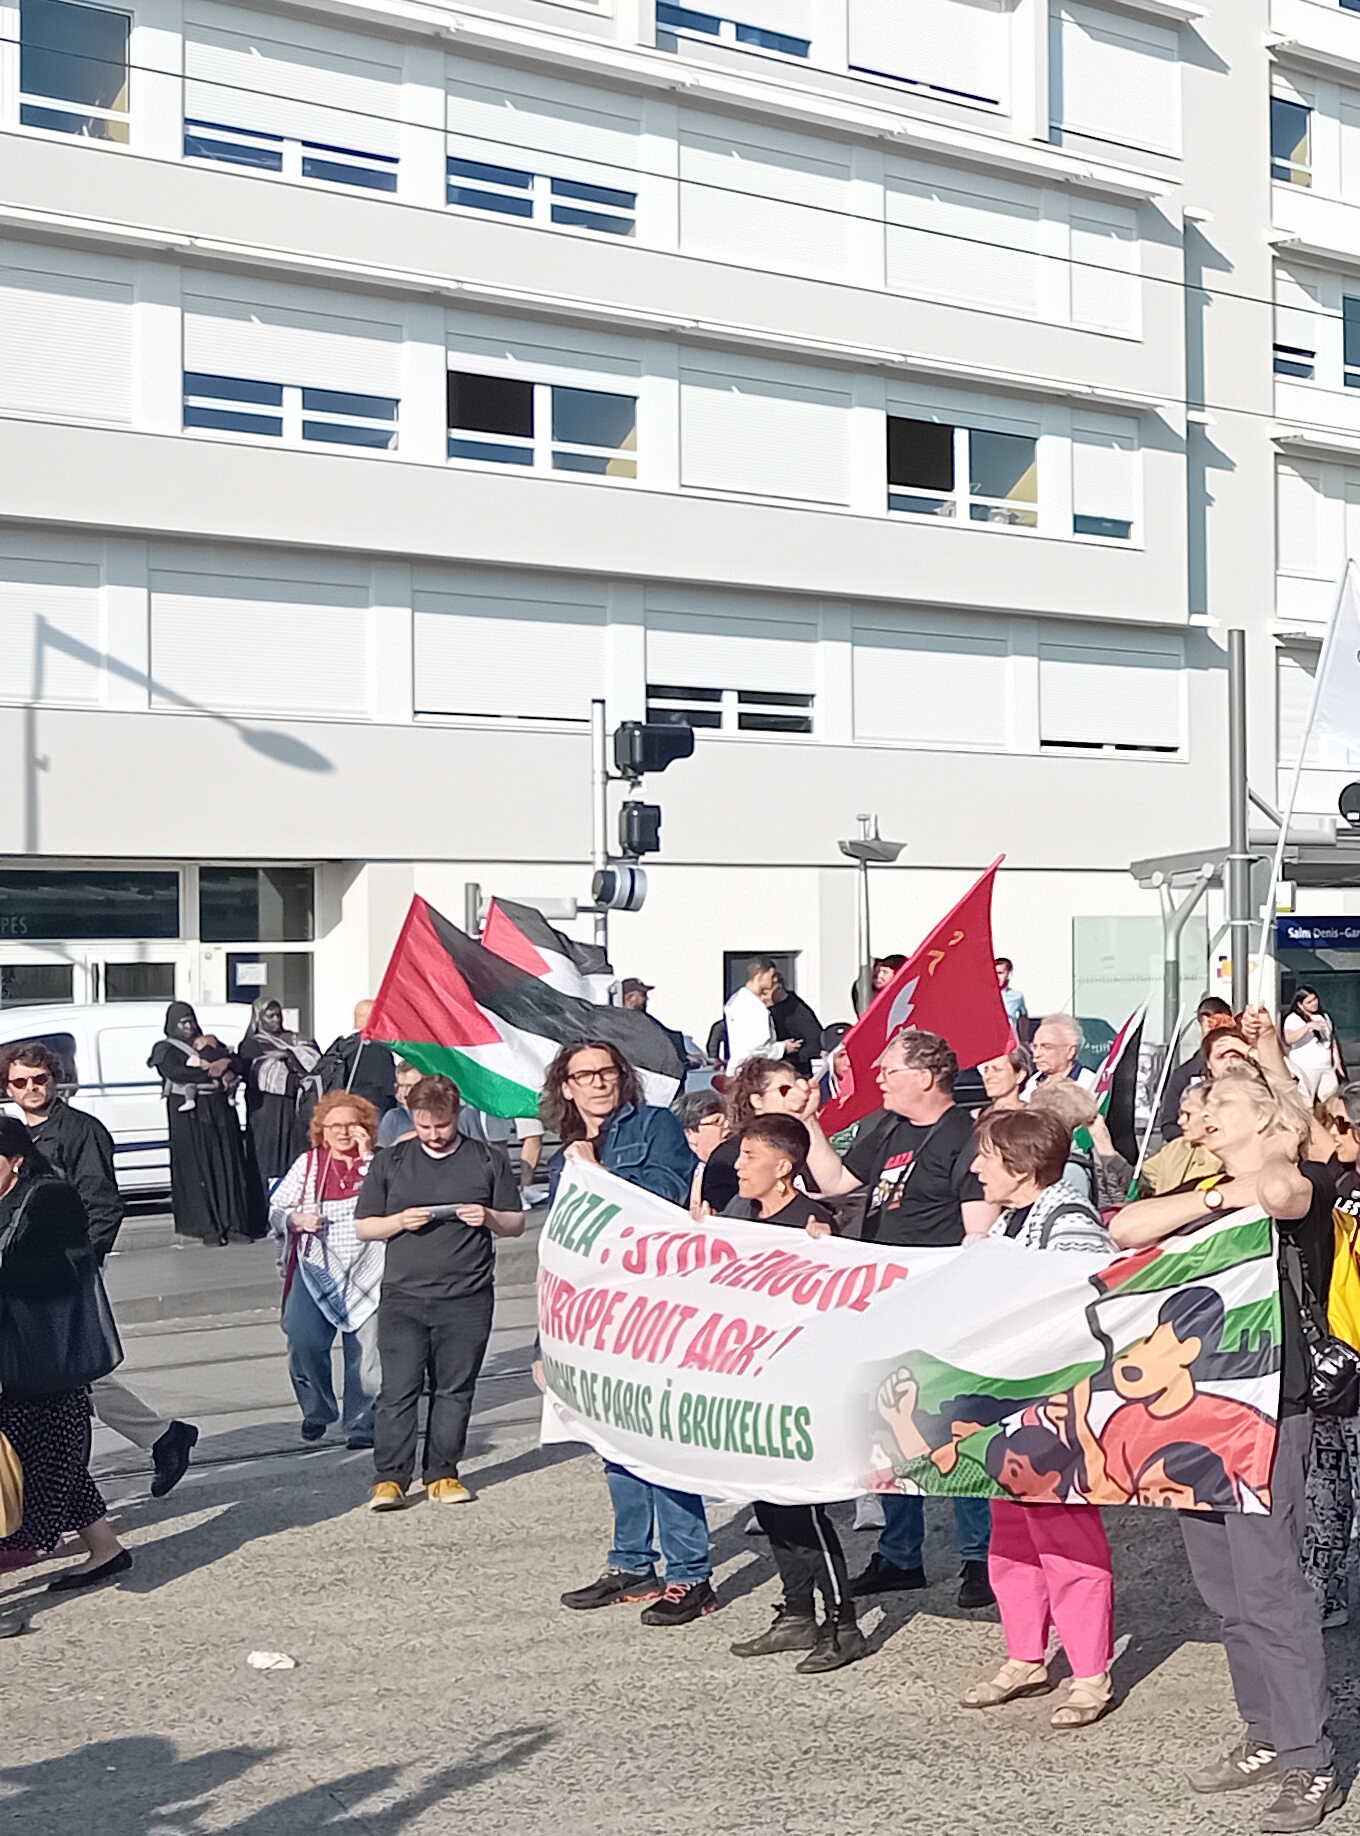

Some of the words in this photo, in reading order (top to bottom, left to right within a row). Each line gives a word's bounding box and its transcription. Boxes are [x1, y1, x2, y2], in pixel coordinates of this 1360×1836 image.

[612, 1295, 700, 1364] DOIT
[580, 1369, 601, 1422] DE
[602, 1375, 654, 1438] PARIS
[659, 1378, 674, 1441] À
[678, 1392, 814, 1462] BRUXELLES
